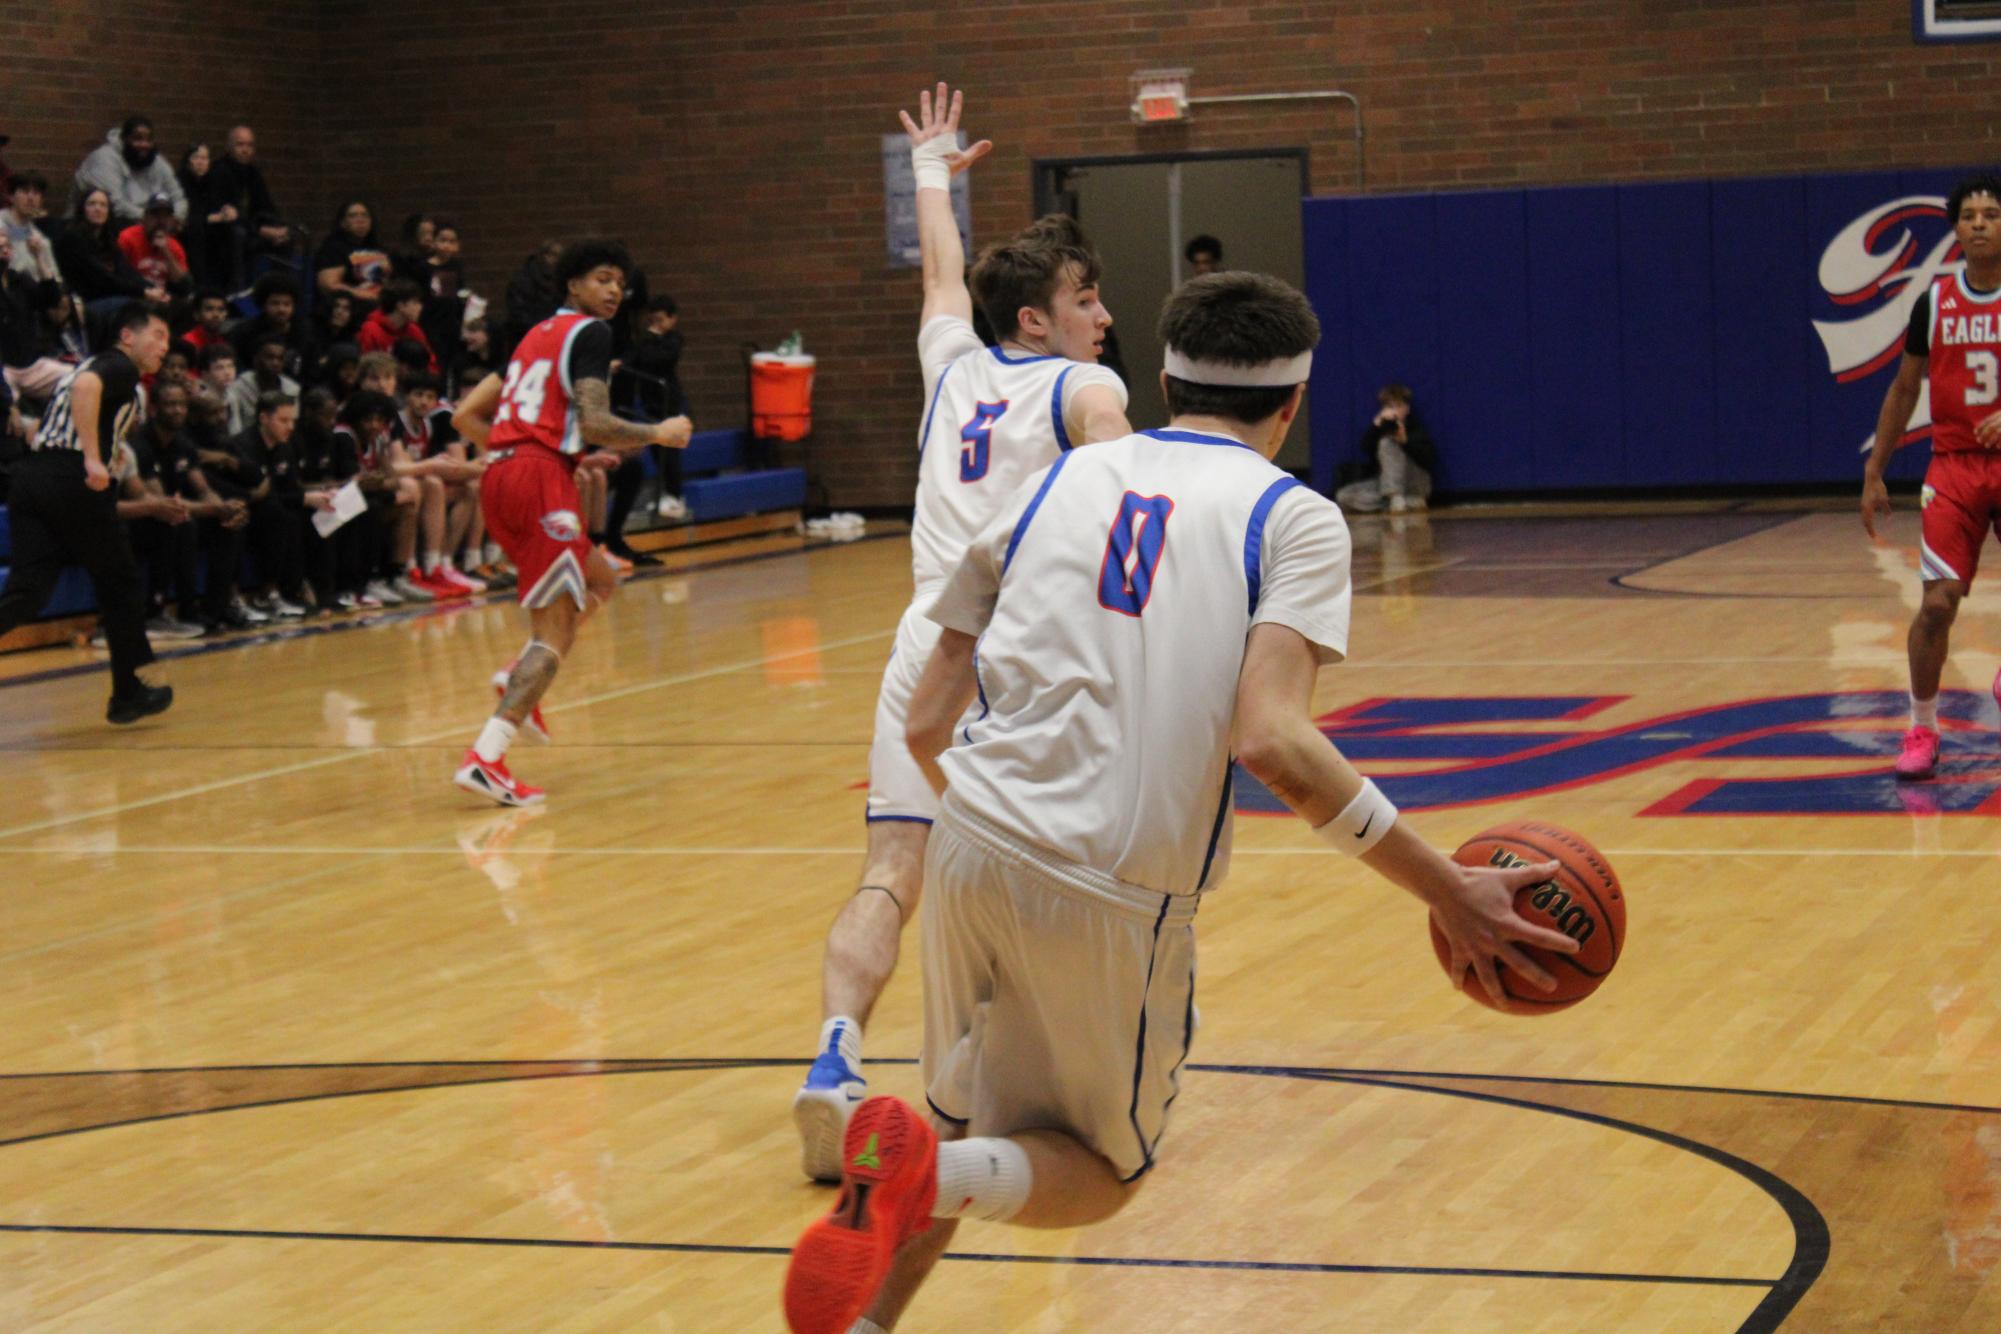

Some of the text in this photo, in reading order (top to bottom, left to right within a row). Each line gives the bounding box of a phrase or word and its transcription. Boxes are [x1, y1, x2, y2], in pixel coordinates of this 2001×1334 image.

[1941, 313, 2001, 346] EAGL
[1964, 351, 1998, 406] 3
[960, 399, 1009, 484] 5
[1097, 490, 1175, 618] 0
[1488, 847, 1596, 951] Wiln
